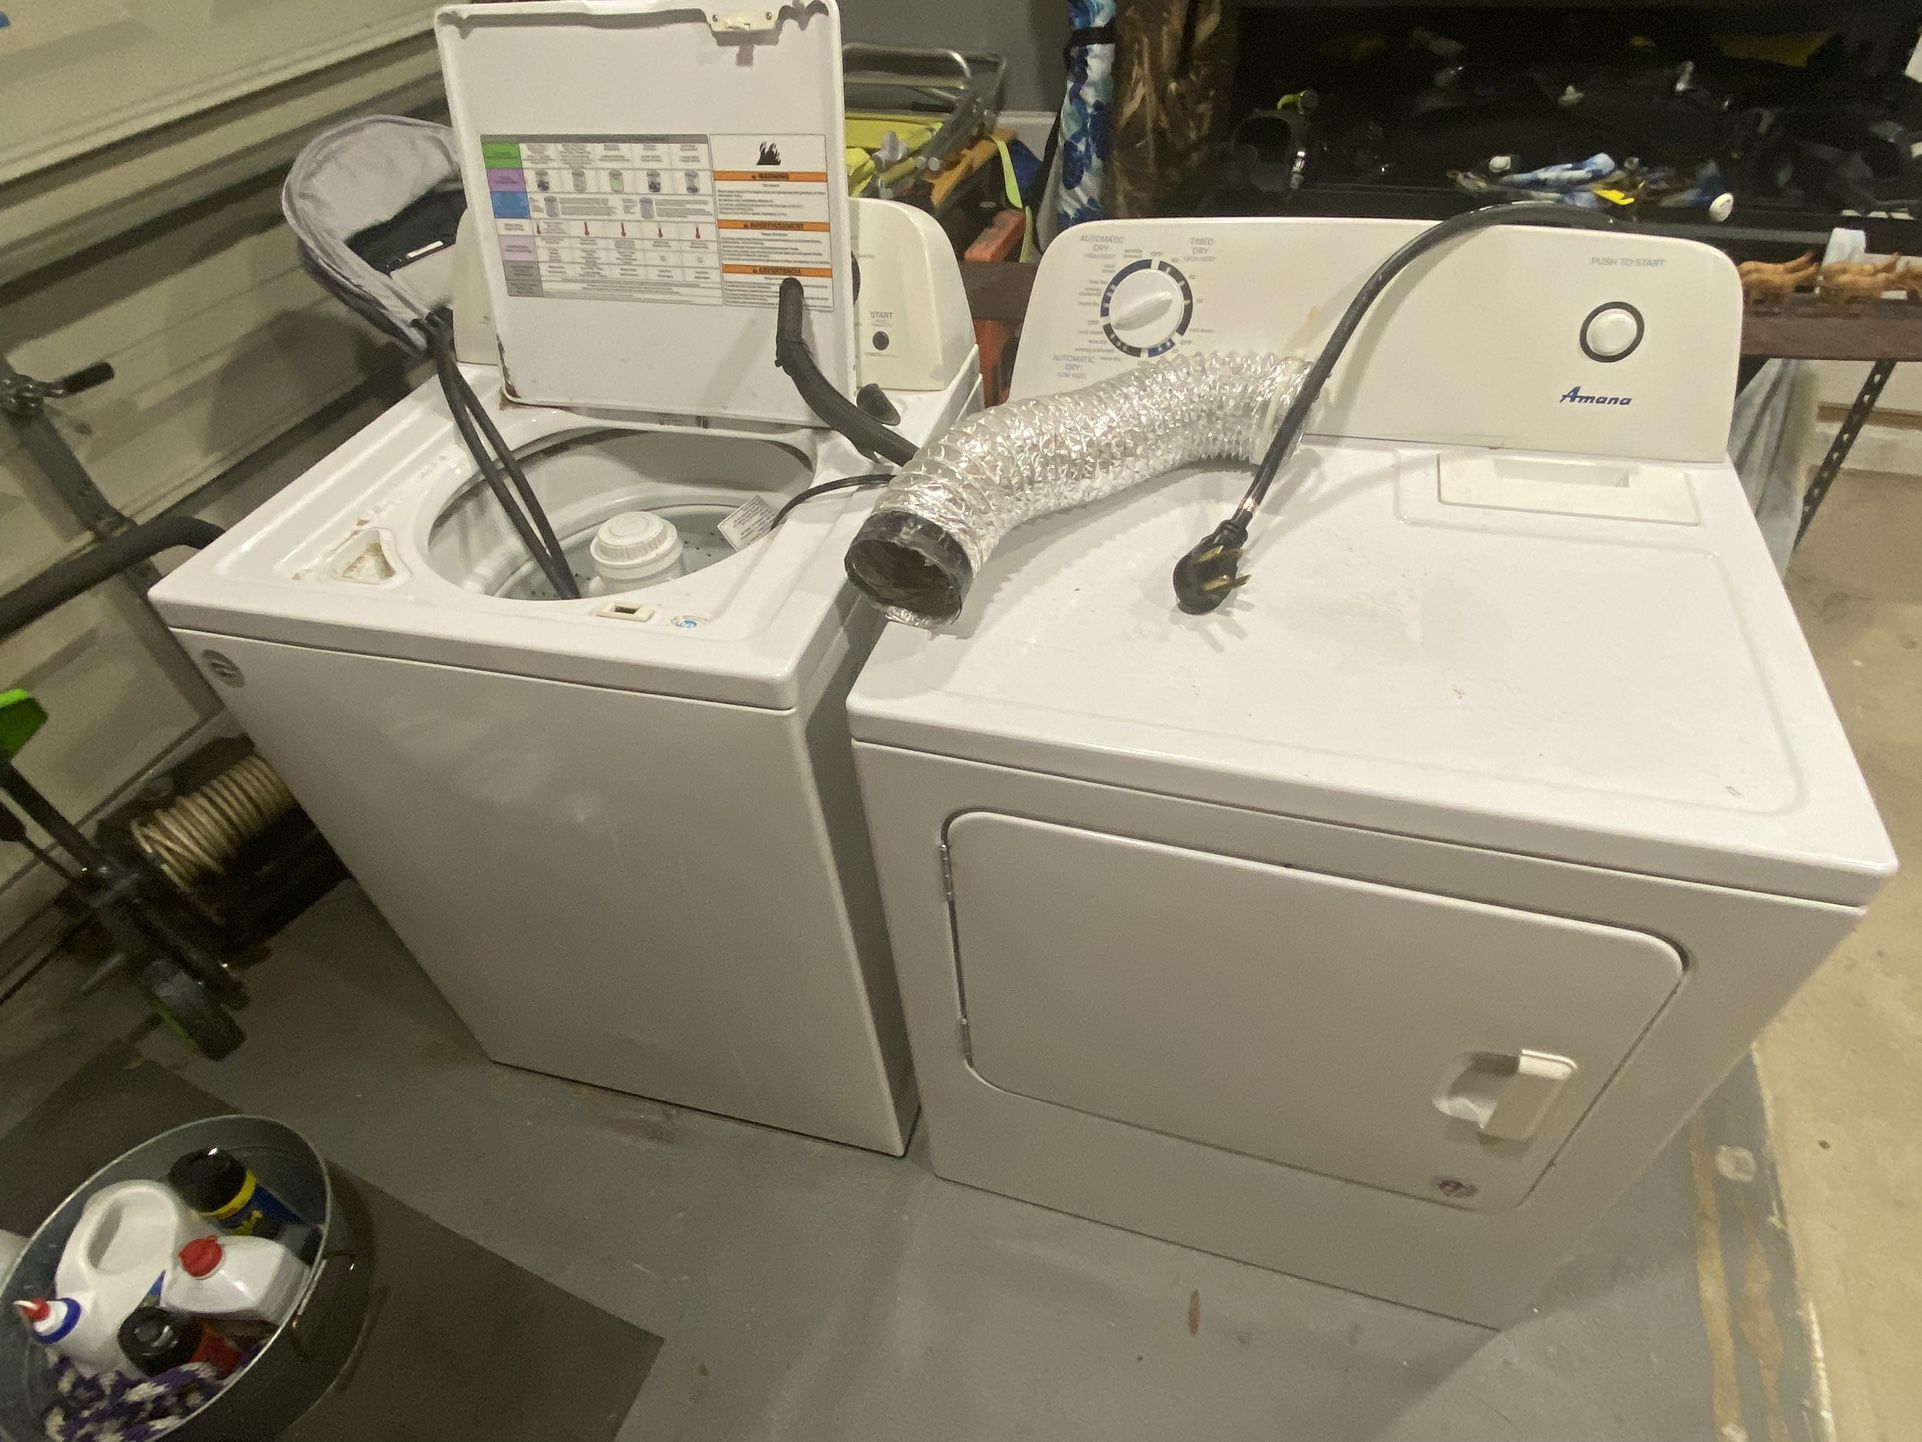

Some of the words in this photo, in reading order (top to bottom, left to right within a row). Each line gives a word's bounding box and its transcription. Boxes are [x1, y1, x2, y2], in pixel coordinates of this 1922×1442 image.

[1080, 234, 1125, 244] AUTOMATIC
[1190, 237, 1214, 246] TIMED
[1093, 244, 1109, 252] DRY
[1192, 246, 1209, 255] DRY
[1590, 256, 1617, 266] PUSH
[1619, 257, 1633, 266] TO
[1635, 258, 1665, 267] START
[870, 311, 893, 319] START
[1052, 354, 1095, 364] AUTOMATIC
[1065, 363, 1081, 371] DRY
[1559, 386, 1632, 405] Amana
